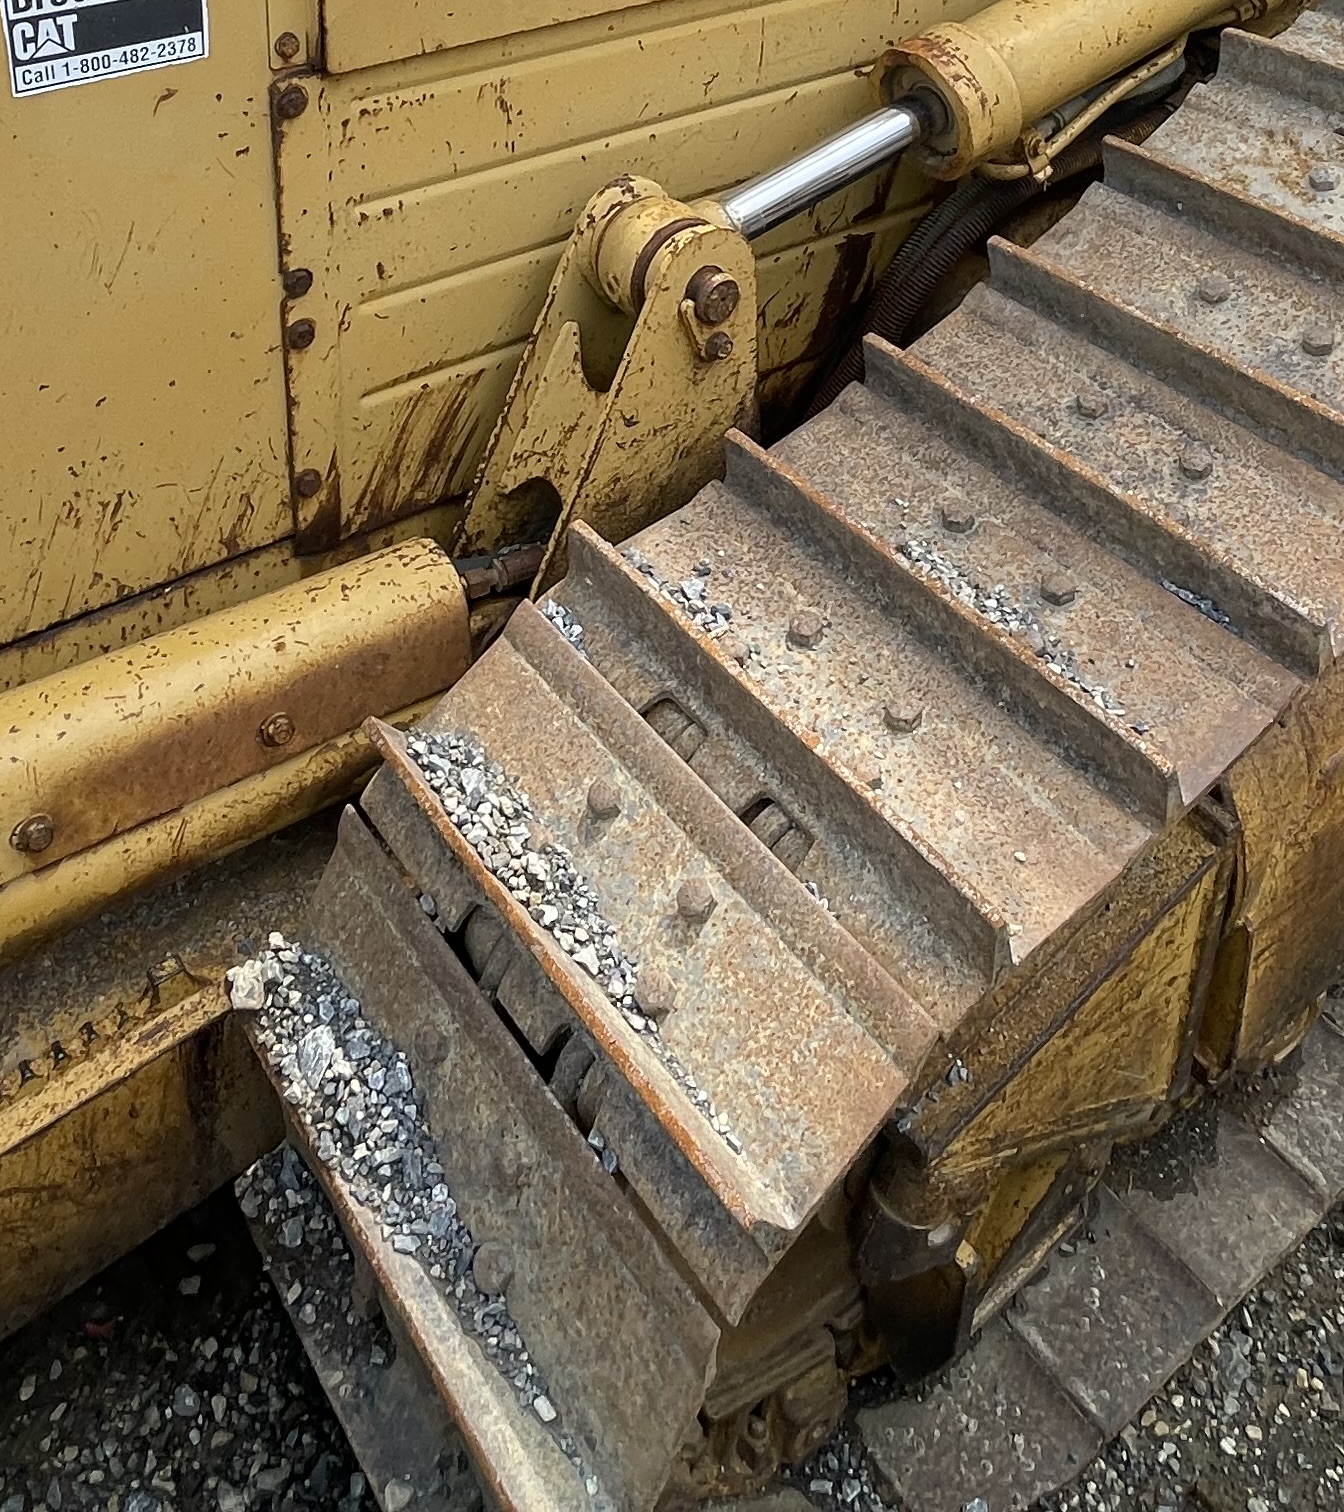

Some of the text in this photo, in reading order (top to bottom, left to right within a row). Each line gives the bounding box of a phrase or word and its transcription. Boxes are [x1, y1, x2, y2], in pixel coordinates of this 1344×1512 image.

[12, 13, 78, 61] CAT
[22, 37, 197, 86] Call 1-800-482-2378
